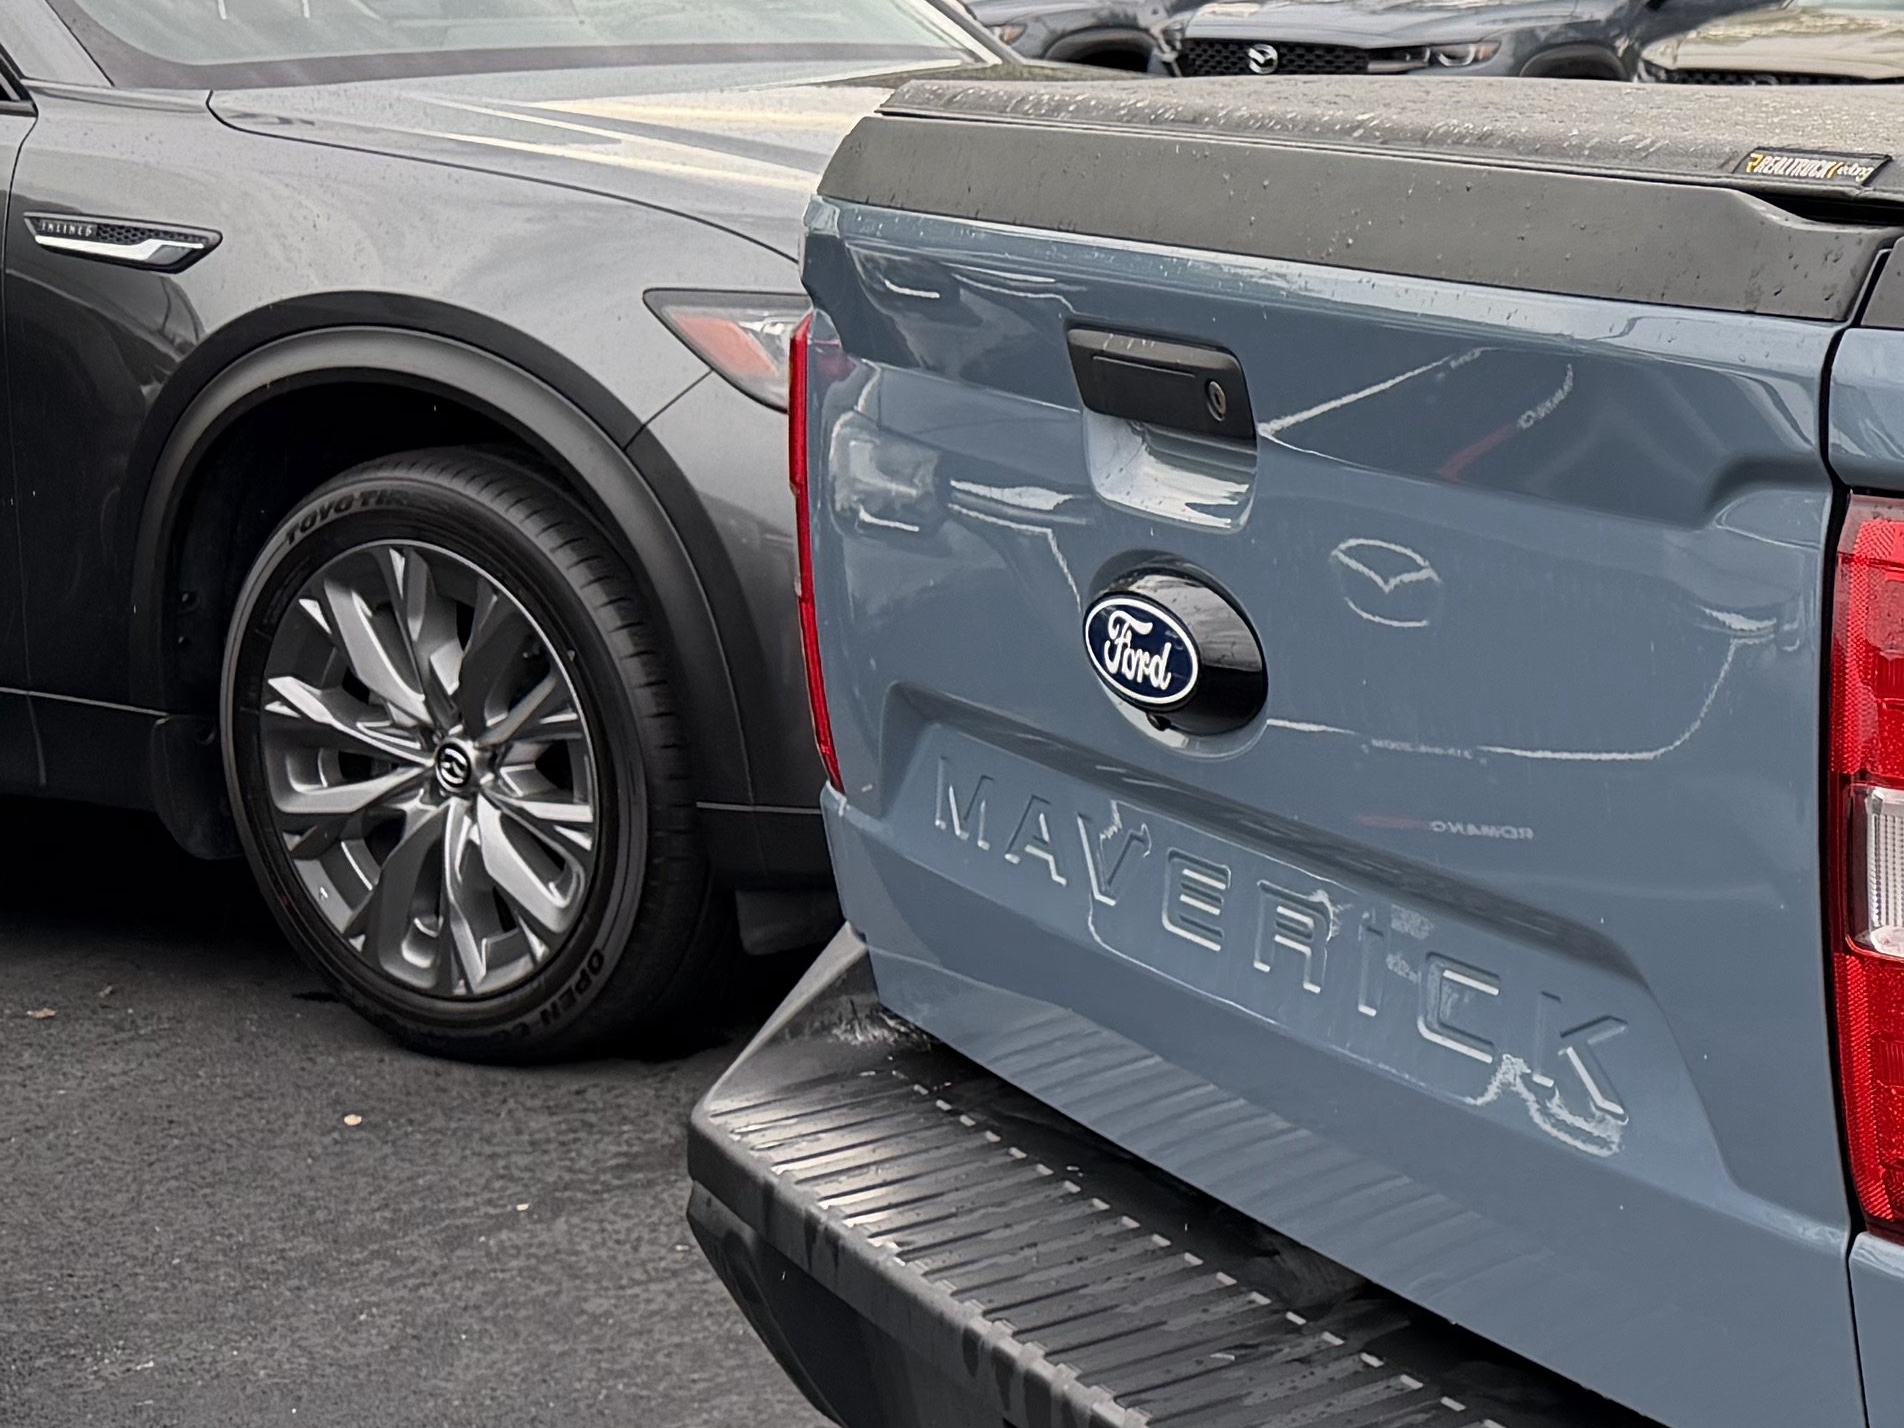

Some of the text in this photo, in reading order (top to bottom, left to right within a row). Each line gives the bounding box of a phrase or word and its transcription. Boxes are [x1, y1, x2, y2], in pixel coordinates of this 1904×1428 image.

[286, 494, 354, 546] TOYO
[1101, 606, 1173, 692] Ford
[934, 755, 1630, 1125] MAVERICK
[540, 948, 604, 1026] OPEN
